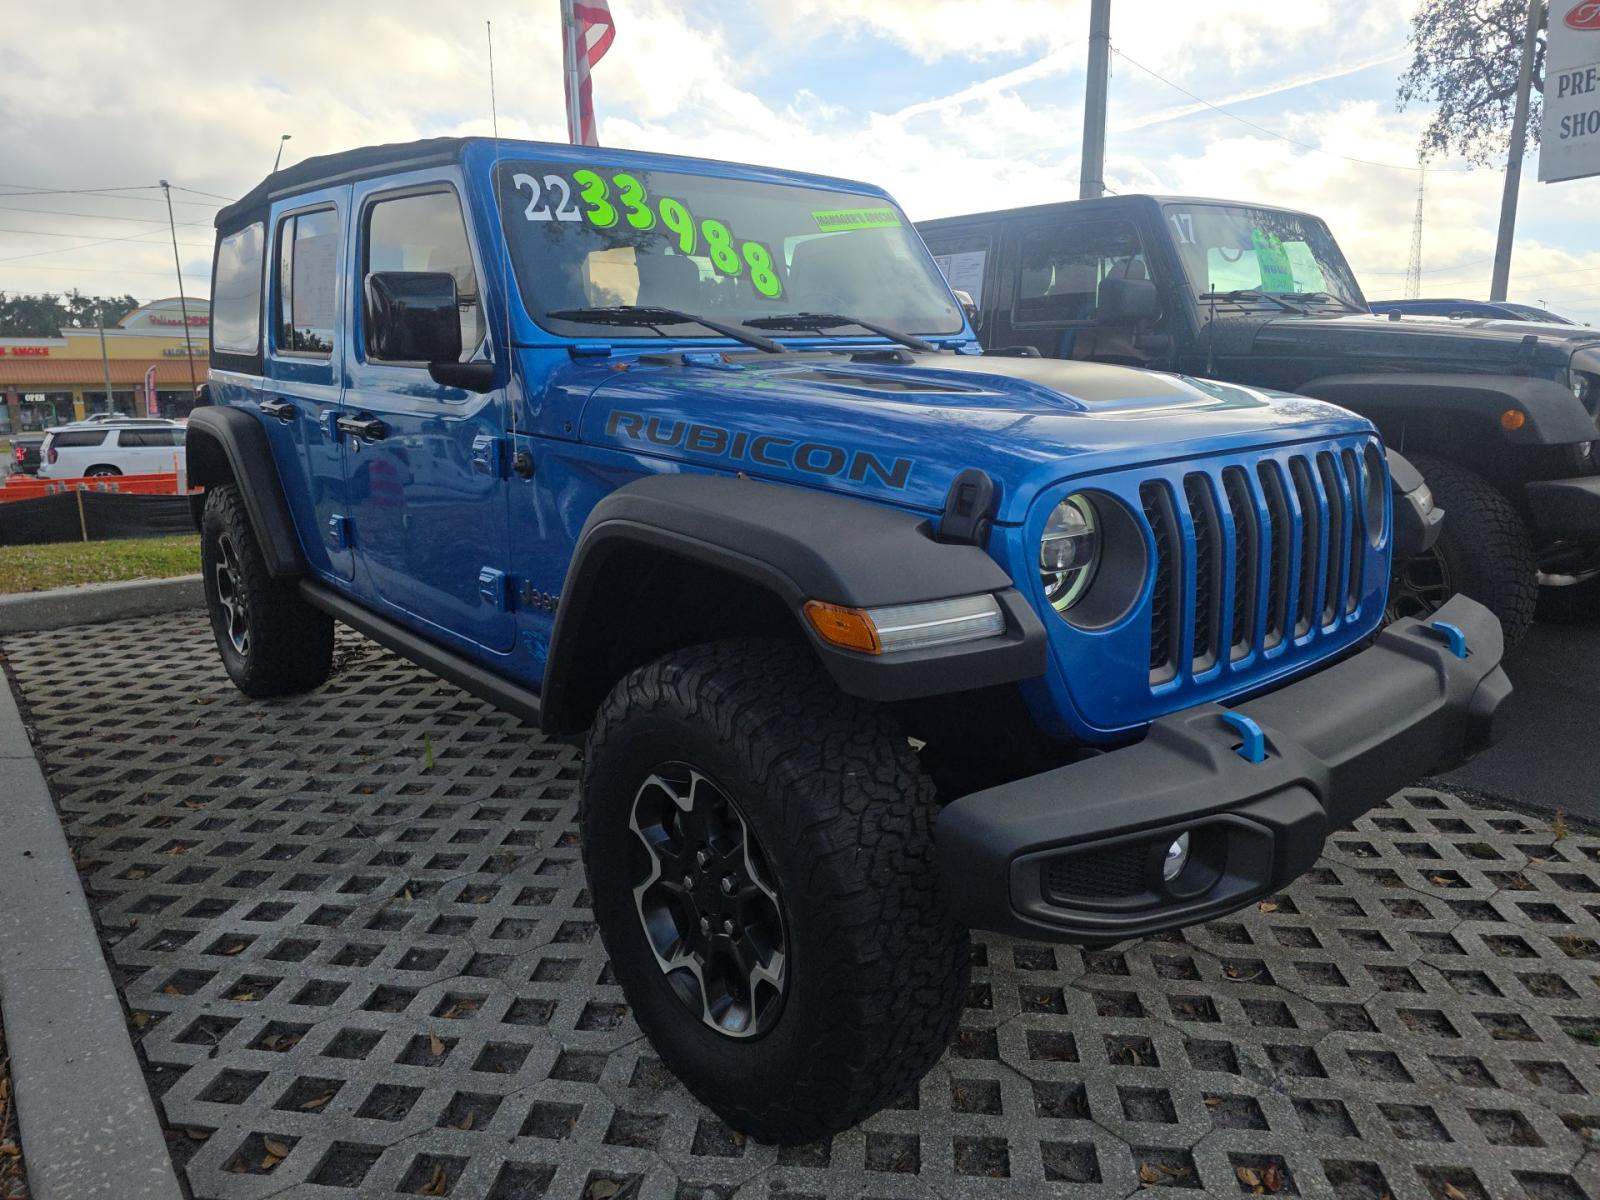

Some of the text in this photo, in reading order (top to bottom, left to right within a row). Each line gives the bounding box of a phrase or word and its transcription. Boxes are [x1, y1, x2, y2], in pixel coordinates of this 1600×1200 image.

[512, 169, 785, 299] 22 33988
[1169, 213, 1196, 245] 17
[24, 393, 46, 403] OPEN
[604, 409, 915, 491] RUBICON
